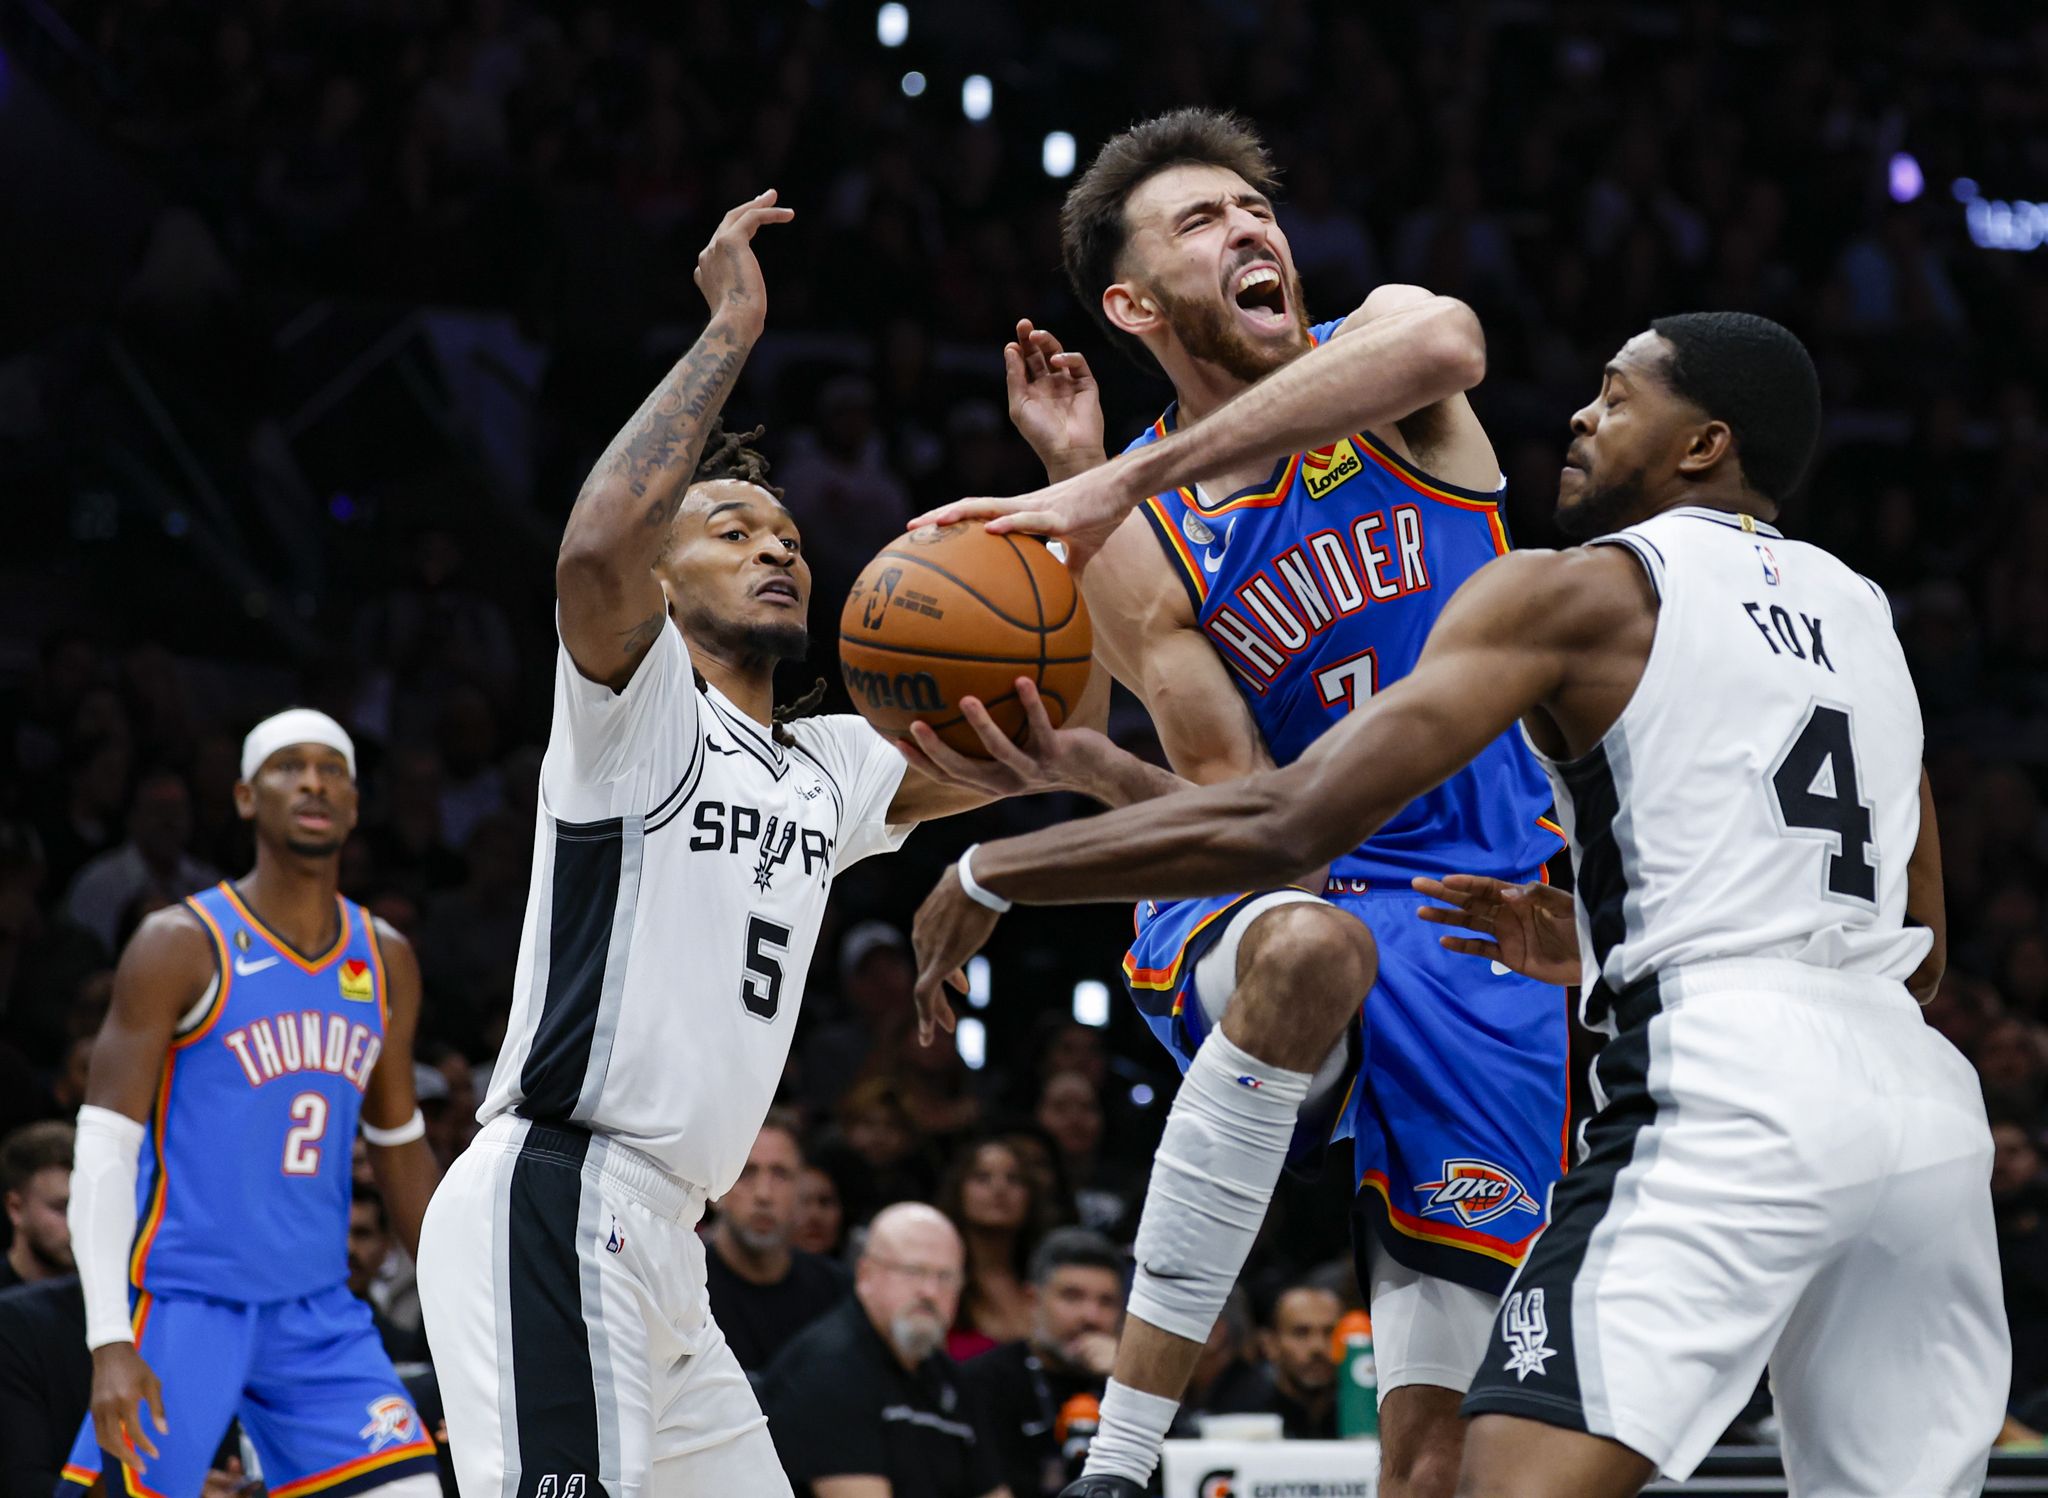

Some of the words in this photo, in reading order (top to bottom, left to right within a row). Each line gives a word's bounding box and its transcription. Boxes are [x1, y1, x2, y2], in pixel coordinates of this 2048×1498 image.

[1203, 502, 1431, 697] HUNDER
[1742, 602, 1836, 674] FOX
[841, 662, 947, 711] Wil
[1311, 647, 1379, 715] 7
[1762, 696, 1880, 916] 4
[739, 911, 793, 1025] 5
[224, 1010, 382, 1092] THUNDER
[282, 1091, 329, 1176] 2
[1433, 1177, 1507, 1203] OKC
